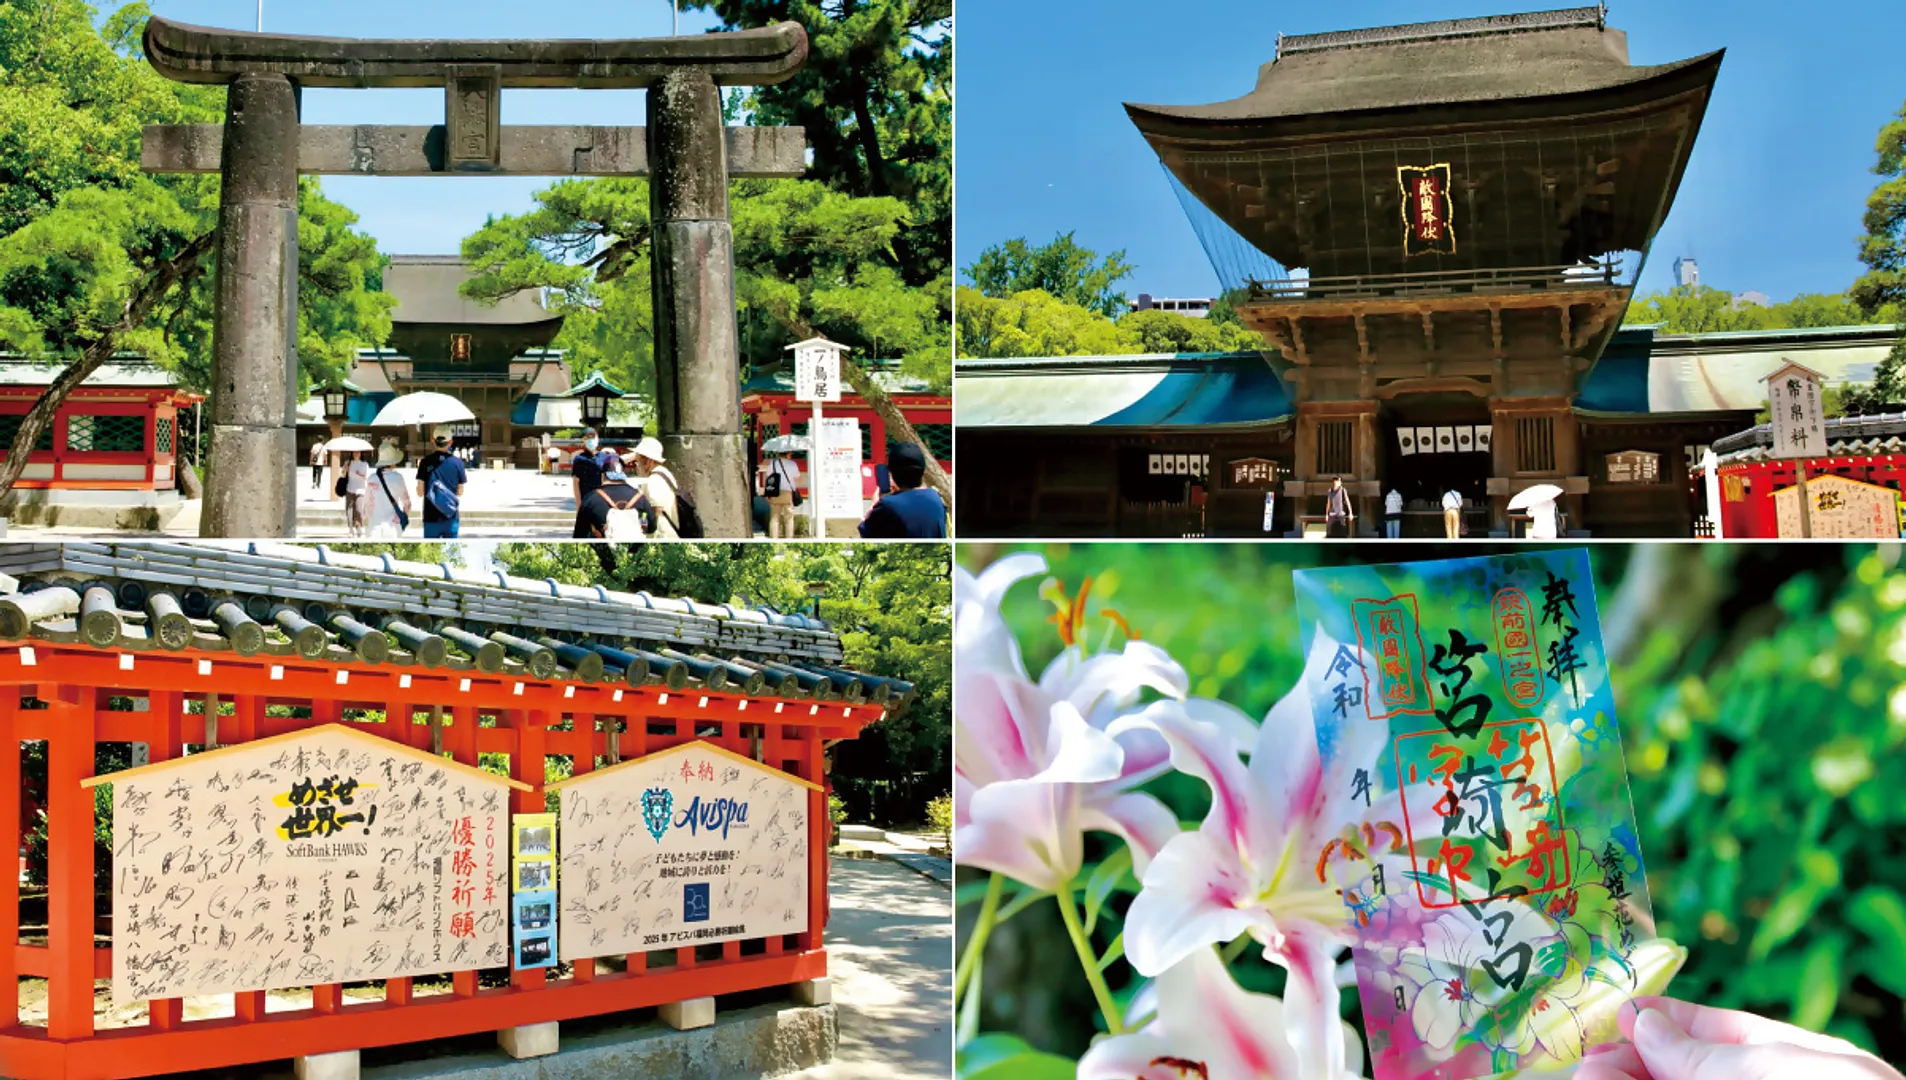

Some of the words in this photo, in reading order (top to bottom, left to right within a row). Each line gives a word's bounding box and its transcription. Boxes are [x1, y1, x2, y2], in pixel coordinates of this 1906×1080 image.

[814, 349, 828, 398] 一ノ鳥居
[1787, 379, 1808, 450] 幣帛料
[288, 774, 359, 806] めざせ
[680, 758, 715, 784] 奉納
[1324, 643, 1367, 719] 令和
[1351, 768, 1373, 807] 年
[1372, 863, 1386, 896] 月
[281, 804, 377, 840] 世界一！
[286, 842, 331, 858] SoftBank
[333, 842, 368, 857] HAWKS
[482, 816, 498, 906] 2025年
[449, 816, 478, 939] 優勝祈願
